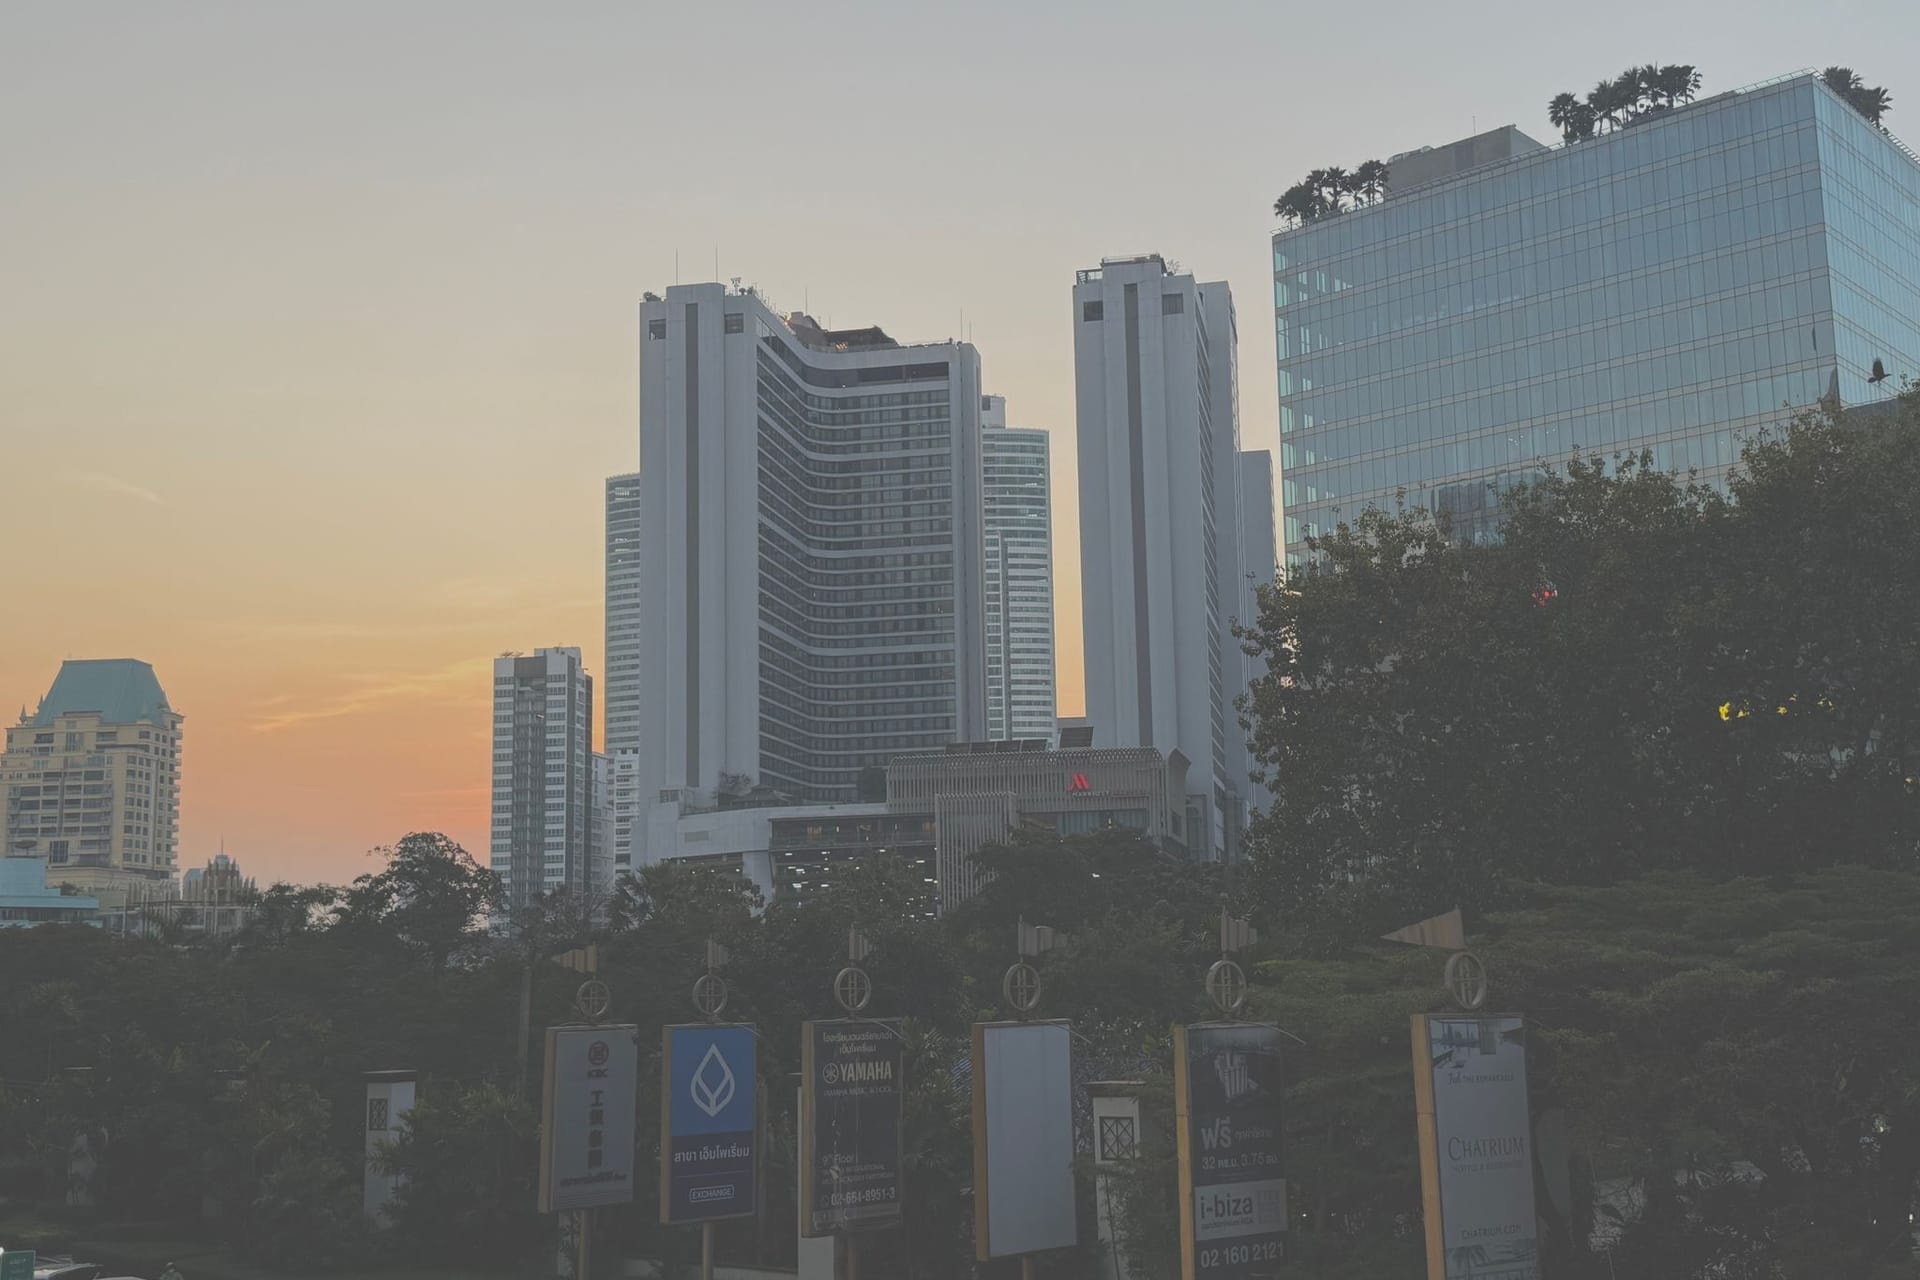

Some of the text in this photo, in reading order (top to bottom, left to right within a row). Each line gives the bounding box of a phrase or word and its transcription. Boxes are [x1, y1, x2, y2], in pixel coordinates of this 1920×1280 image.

[840, 1061, 893, 1082] YAMAHA
[674, 1143, 750, 1163] สาขา เอ็มโพเรียม
[1448, 1136, 1525, 1161] CHATRIUM
[1201, 1155, 1216, 1170] 32
[1200, 1192, 1254, 1219] i-biza
[1200, 1240, 1283, 1269] 02 160 2121
